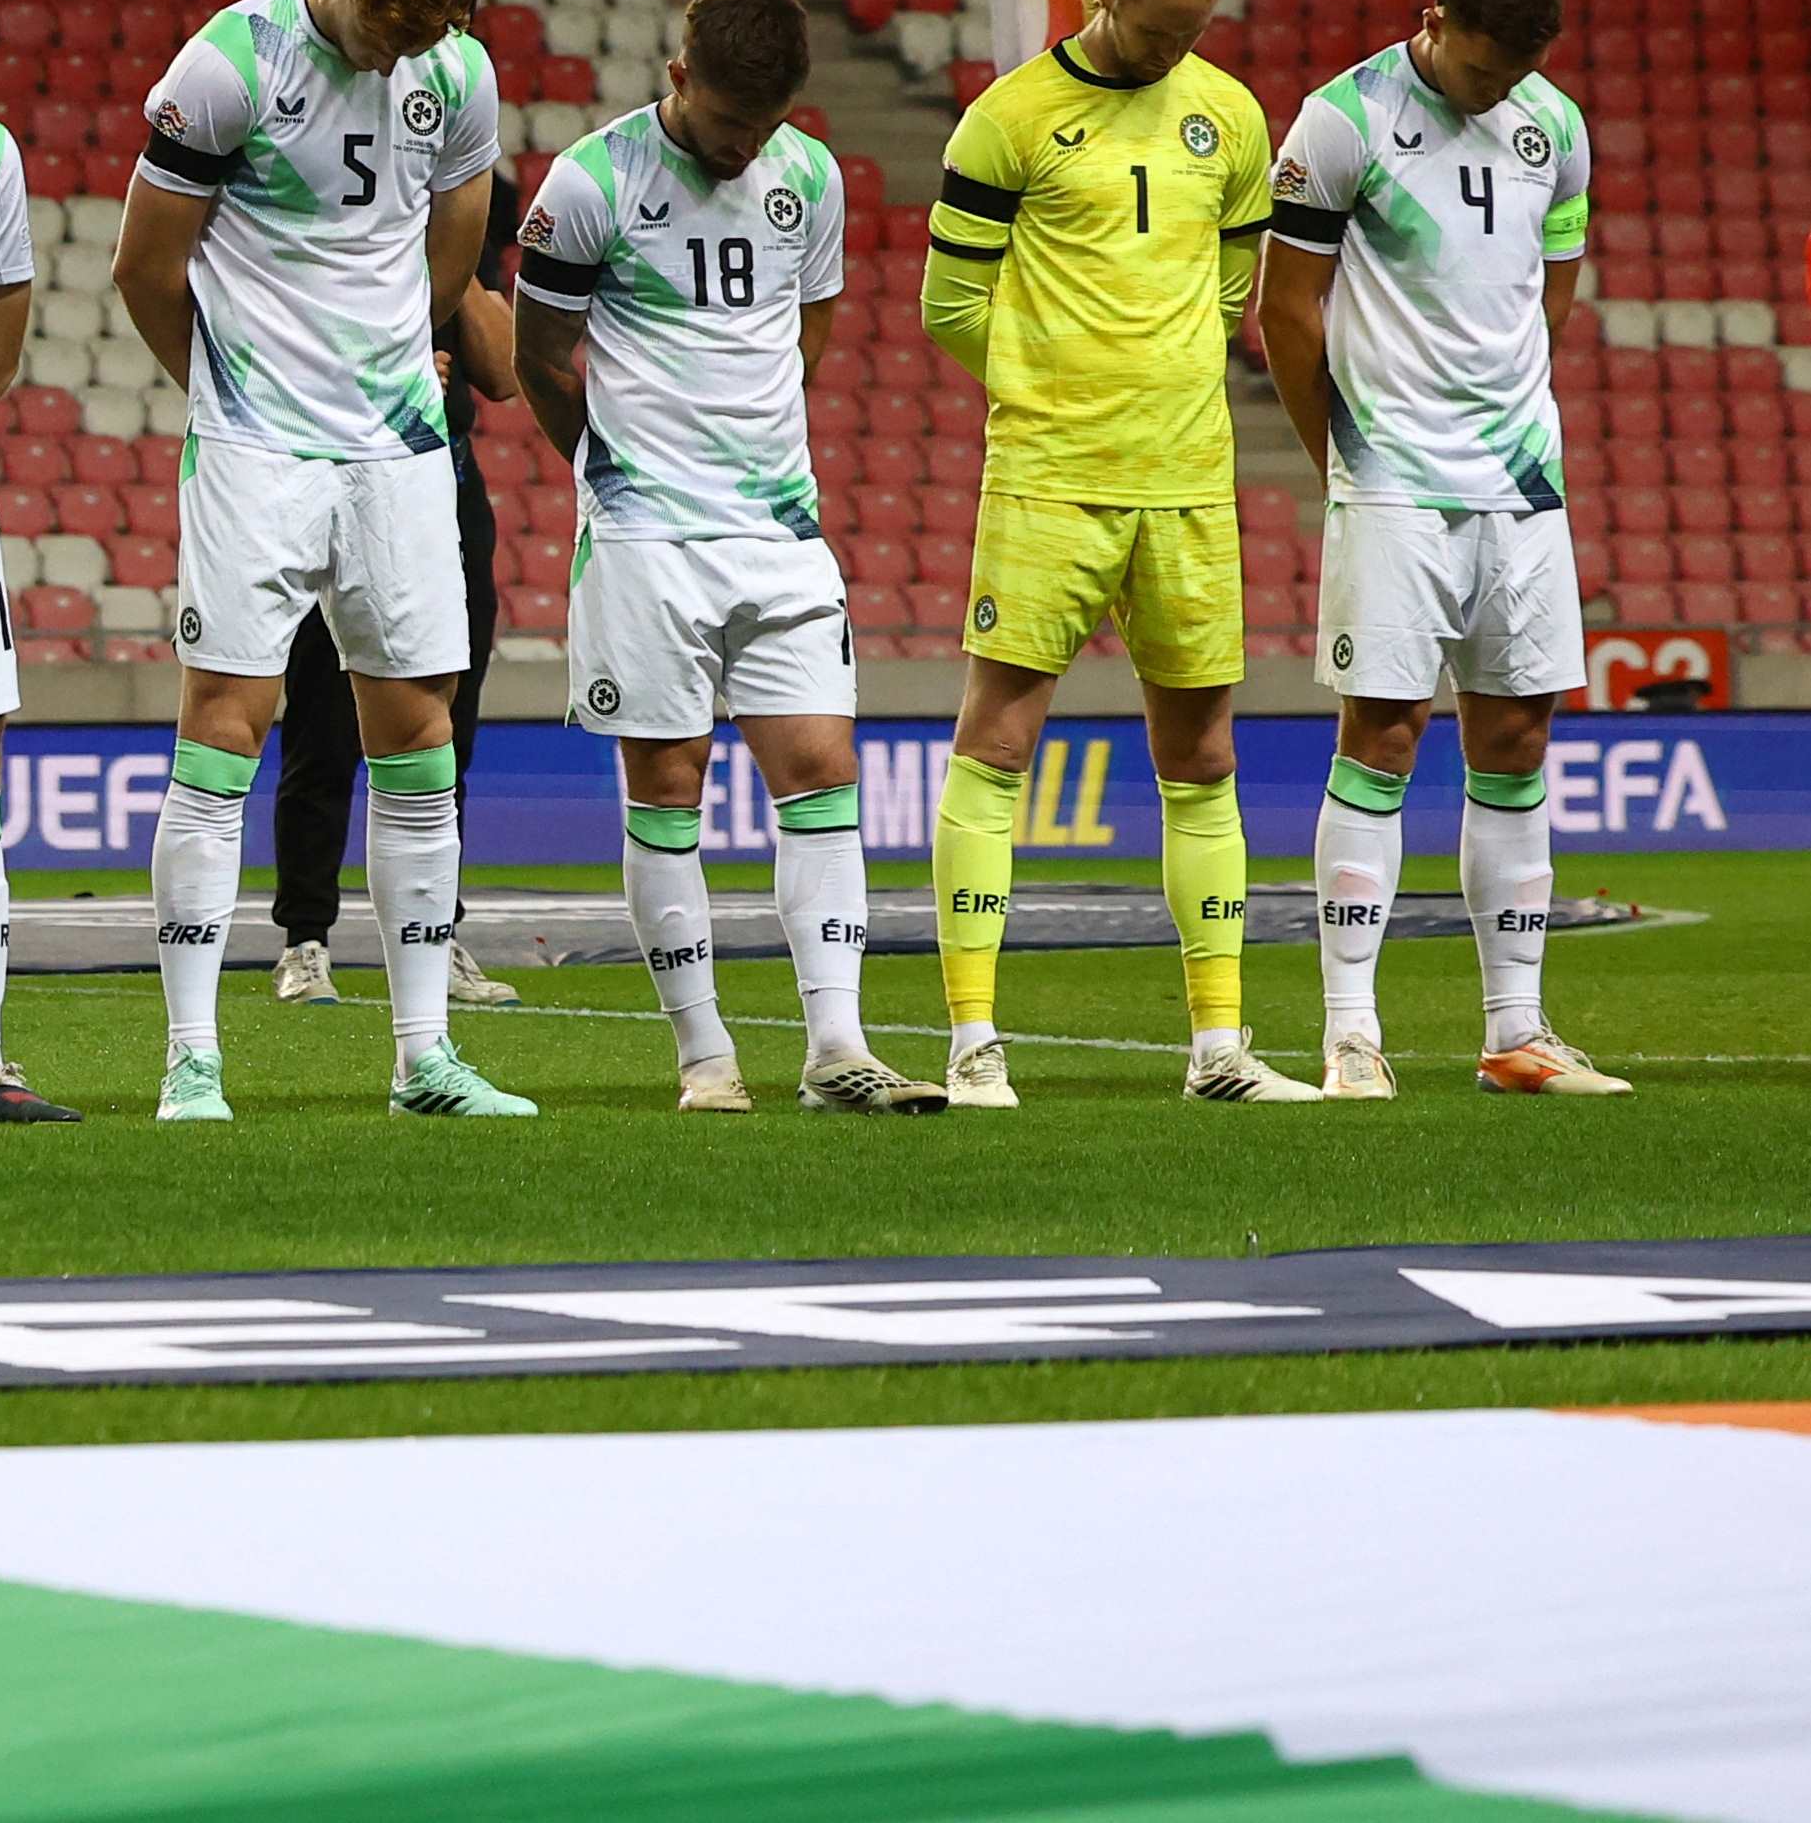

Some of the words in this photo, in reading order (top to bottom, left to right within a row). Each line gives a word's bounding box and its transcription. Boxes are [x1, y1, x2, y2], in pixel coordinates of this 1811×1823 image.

[341, 134, 377, 206] 5
[1130, 165, 1149, 234] 1
[1459, 165, 1494, 235] 4
[686, 237, 753, 307] 18
[1545, 740, 1727, 832] EFA
[158, 922, 222, 945] ÉIRE
[1323, 901, 1383, 927] ÉIRE
[1497, 910, 1545, 933] ÉIR
[648, 939, 707, 972] ÉIRE
